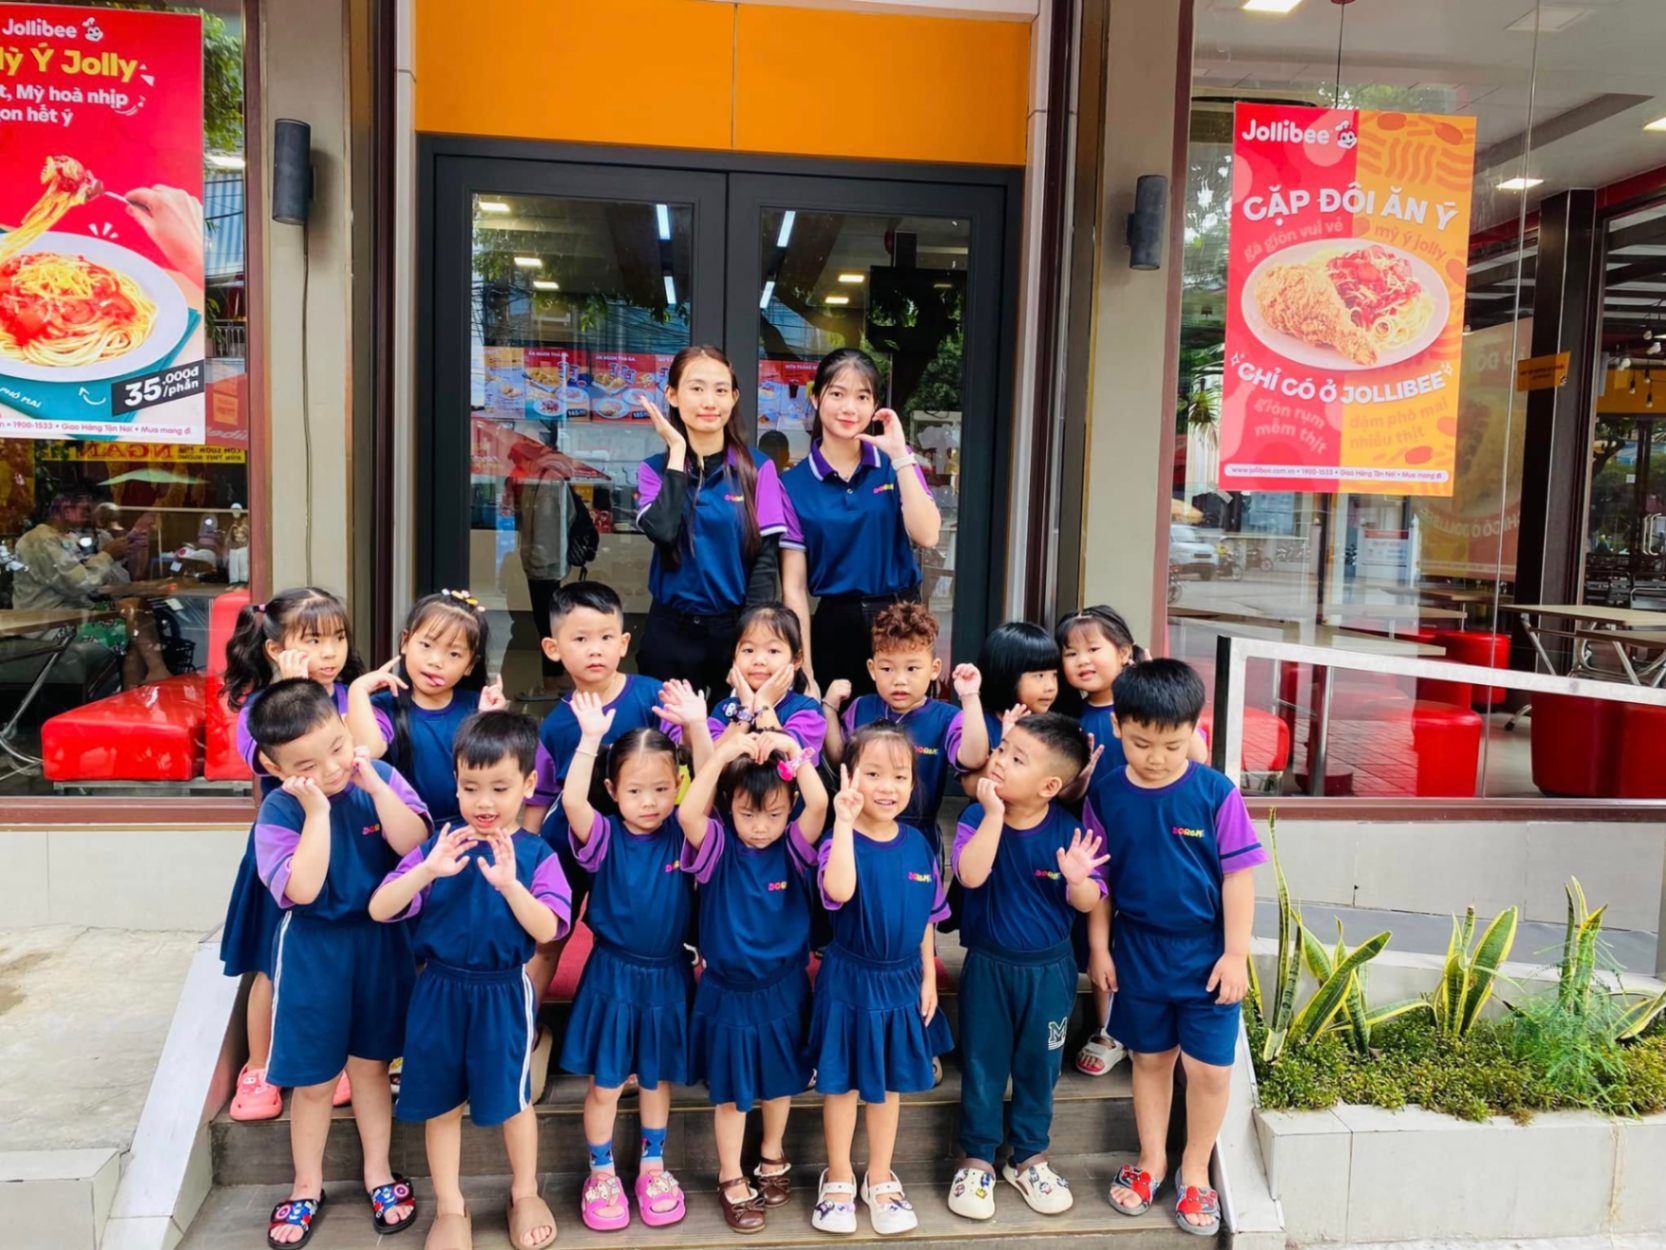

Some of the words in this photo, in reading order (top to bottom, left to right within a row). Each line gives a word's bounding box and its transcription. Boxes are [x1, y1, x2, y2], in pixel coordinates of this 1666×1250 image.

[2, 18, 78, 39] Jollibee
[0, 46, 24, 76] ỳ
[61, 50, 138, 83] Jolly
[16, 83, 45, 104] Mỳ
[49, 86, 83, 104] hoà
[87, 88, 128, 109] nhịp
[27, 104, 57, 123] hết
[1242, 119, 1330, 144] Jollibee
[1242, 184, 1311, 226] CẶP
[1317, 181, 1375, 215] ĐÔI
[1381, 186, 1427, 224] ĂN
[1264, 230, 1298, 253] giòn
[1300, 221, 1322, 238] vui
[1411, 236, 1447, 261] jolly
[1238, 362, 1280, 391] CHỈ
[1281, 377, 1315, 400] CÓ
[1319, 379, 1337, 403] Ở
[1340, 371, 1446, 404] JOLLIBEE
[1253, 398, 1291, 417] giòn
[1420, 399, 1448, 418] mai
[13, 420, 53, 430] 1900-1533
[61, 422, 80, 432] Giao
[141, 426, 159, 434] Mua
[160, 427, 182, 436] mang
[1300, 427, 1328, 454] thịt
